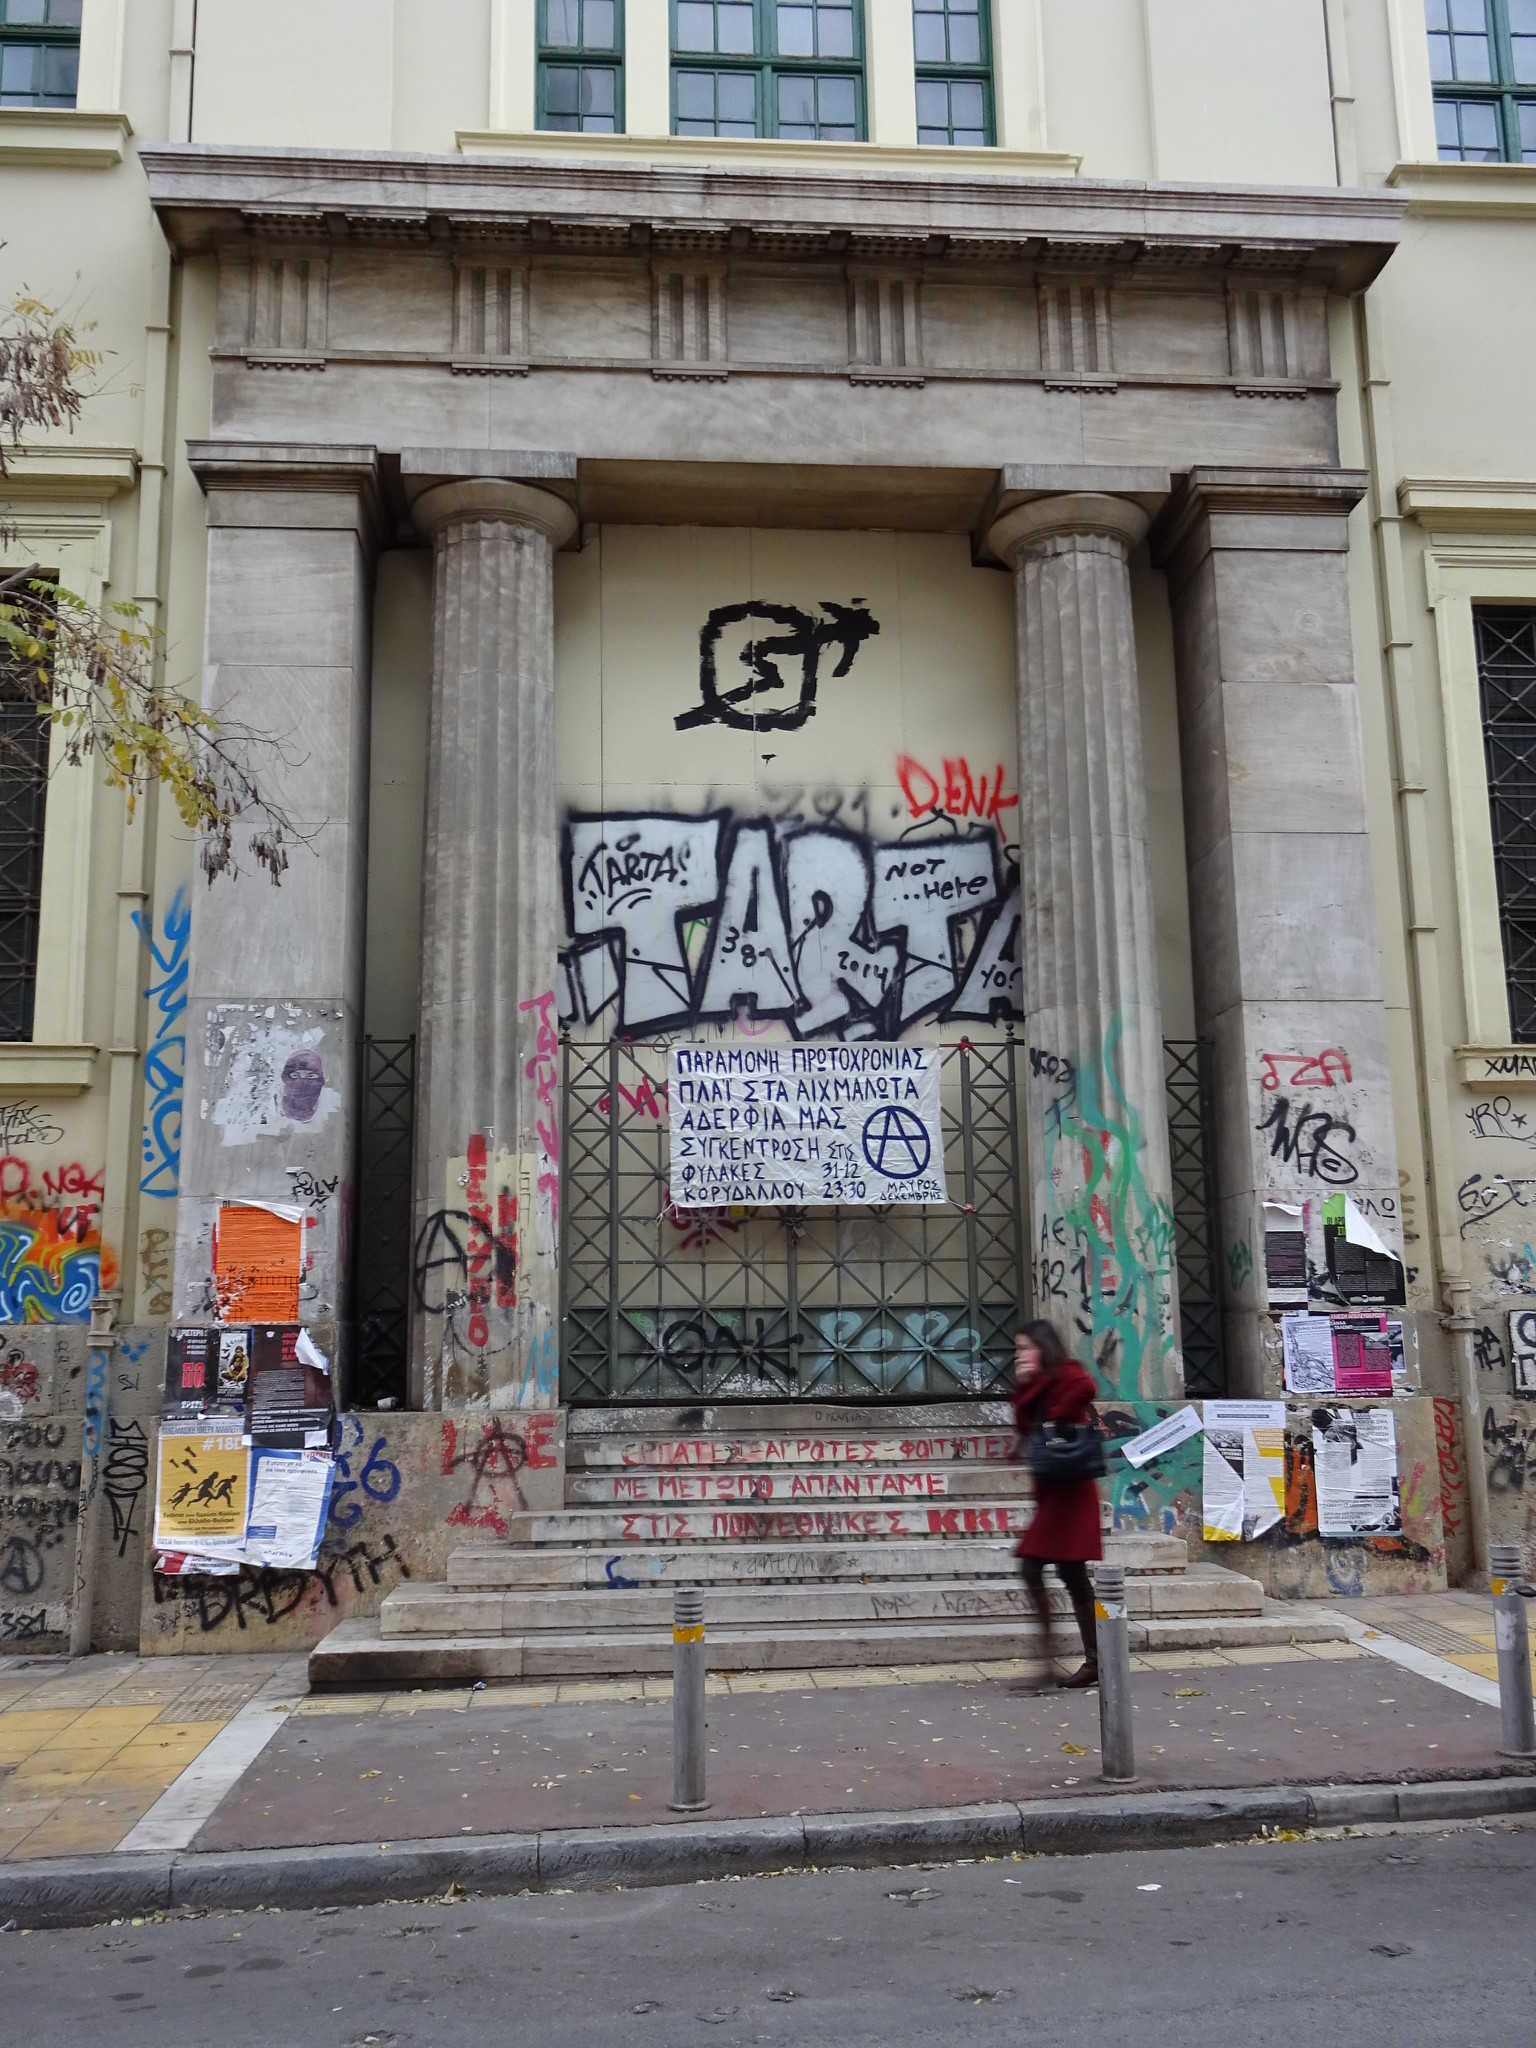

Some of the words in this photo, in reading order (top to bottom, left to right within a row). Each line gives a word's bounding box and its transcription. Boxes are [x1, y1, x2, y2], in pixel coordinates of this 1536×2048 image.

[885, 858, 946, 882] NOT
[837, 950, 890, 993] 2014
[677, 1049, 779, 1074] ΠΑΡΑΜΟΝΗ
[792, 1047, 928, 1073] ΠΡΩΤΟΧΡΟΝΙΑΣ
[743, 1080, 789, 1103] ΣΤΑ
[797, 1077, 920, 1102] ΑΙΧΜΑΛΩΤΑ
[680, 1107, 786, 1131] ΑΔΕΡΦΙΑ
[800, 1106, 847, 1131] ΜΑΣ
[680, 1136, 820, 1162] ΣΥΓΚΕΝΤΡΩΣΗ
[827, 1141, 858, 1162] ΣΤΙΣ
[682, 1162, 765, 1184] ΦΥΛΑΚΕΣ
[821, 1162, 861, 1179] 31-12
[684, 1182, 805, 1202] ΚΟΡΥΔΑΛΛΟΥ
[822, 1180, 867, 1199] 23:30
[880, 1190, 944, 1201] ΔΕΚΕΜΒΡΗΣ
[887, 1180, 942, 1194] ΜΑΥΡΟΣ
[614, 1477, 649, 1499] ΜΕ
[791, 1472, 947, 1497] ΑΠΑΝΤΑΜΕ
[621, 1513, 695, 1541] ΣΤΙΣ
[927, 1507, 1019, 1534] ΚΚΕ
